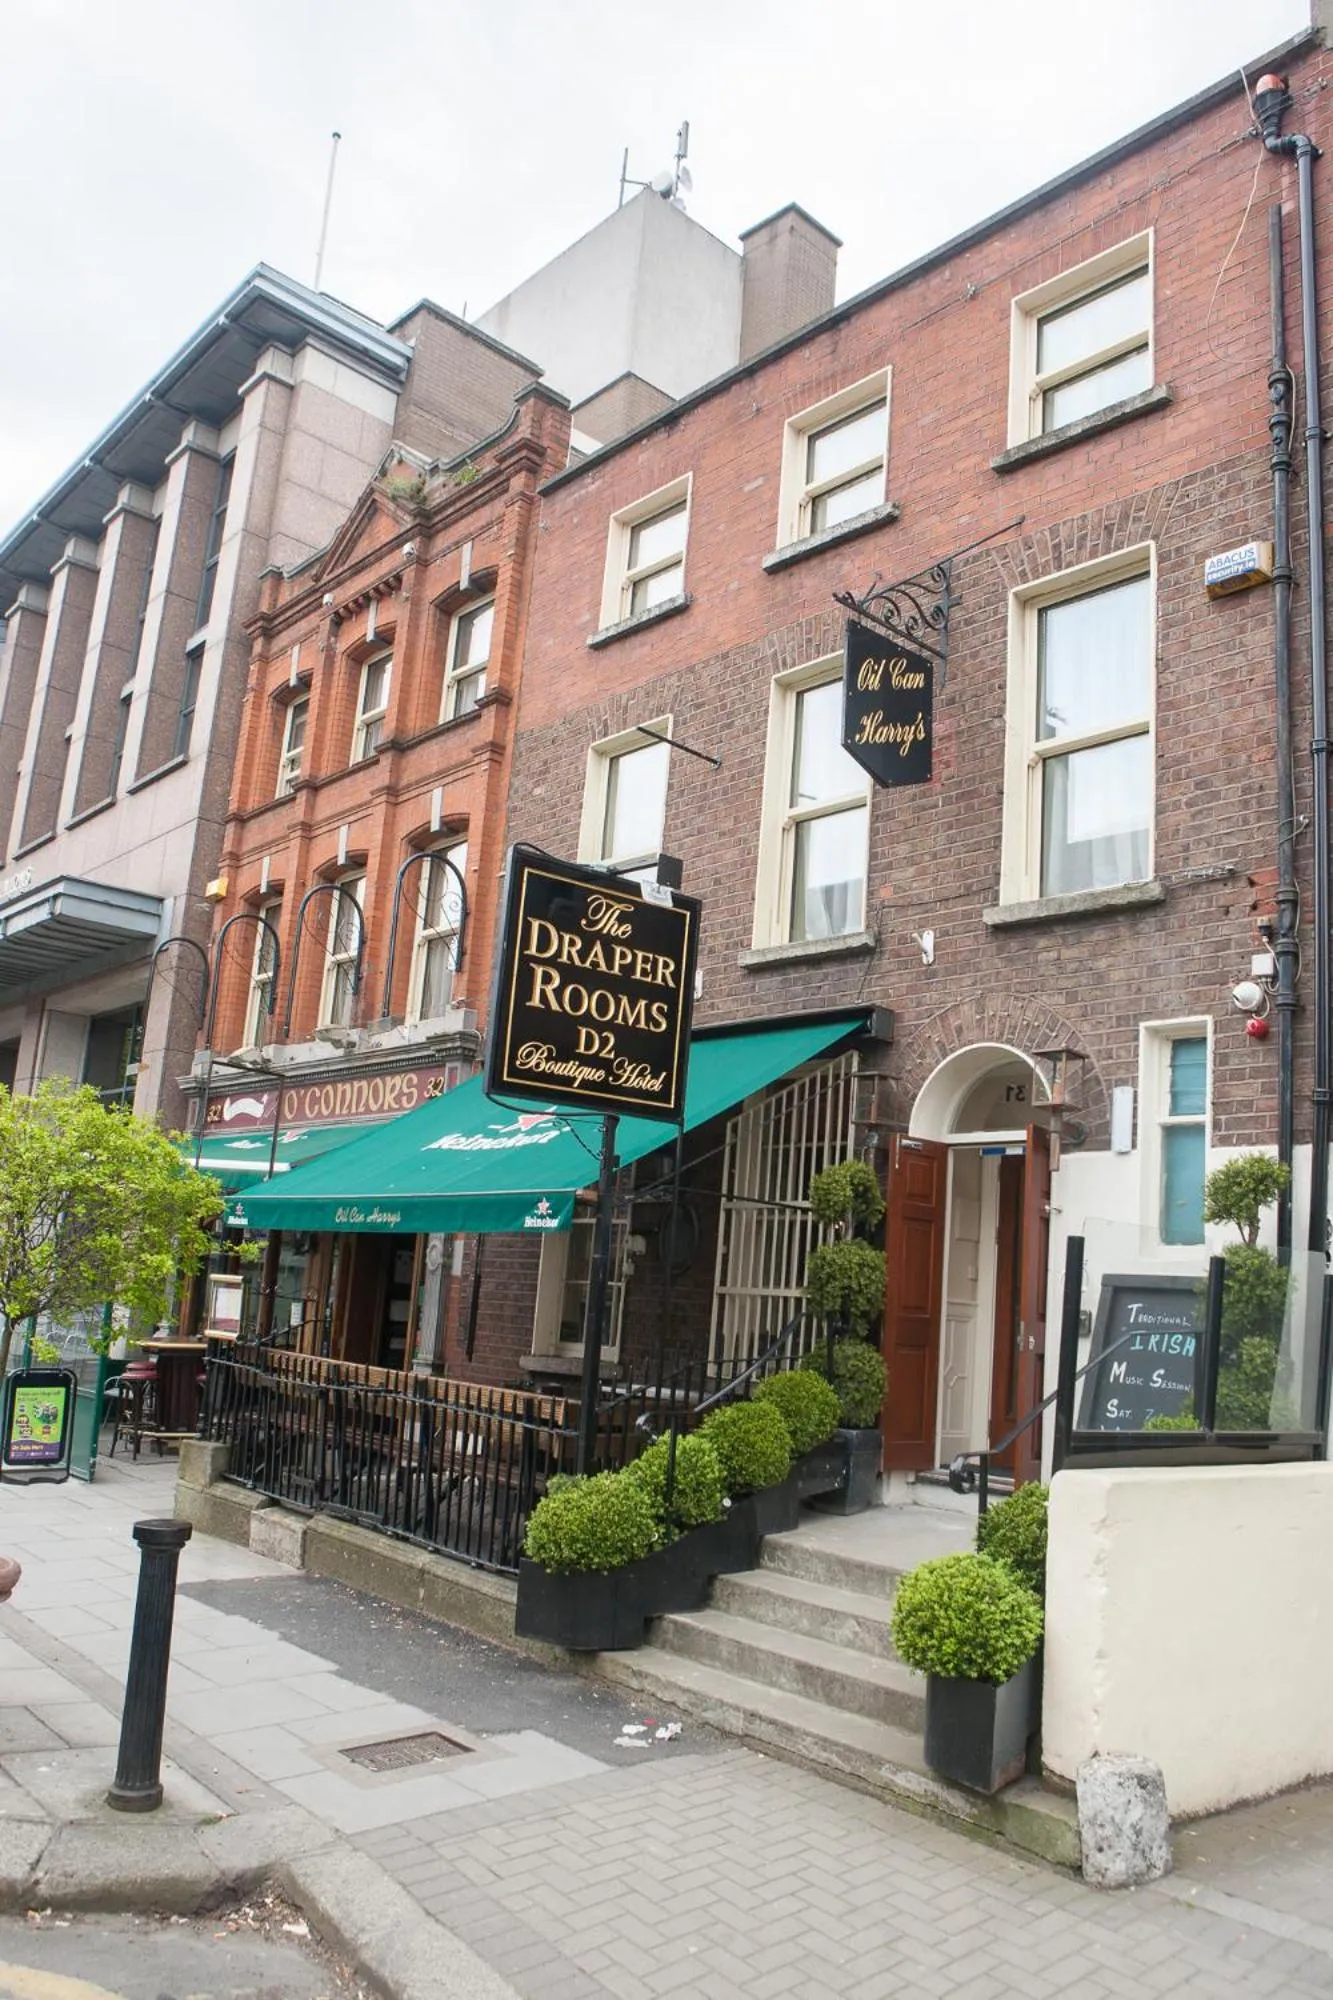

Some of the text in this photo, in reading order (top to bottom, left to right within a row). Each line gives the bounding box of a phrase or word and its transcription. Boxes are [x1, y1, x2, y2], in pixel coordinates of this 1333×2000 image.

[1208, 547, 1254, 571] ABACUS
[857, 656, 925, 692] Oil Can
[855, 709, 926, 757] Harry's
[581, 895, 634, 940] The
[524, 917, 677, 988] DRAPER
[525, 963, 668, 1033] ROOMS
[576, 1025, 615, 1059] D2
[515, 1041, 666, 1092] Boutique Hotel
[207, 1073, 444, 1122] 32 O'CONNORS 32
[1130, 1333, 1196, 1356] IRISH
